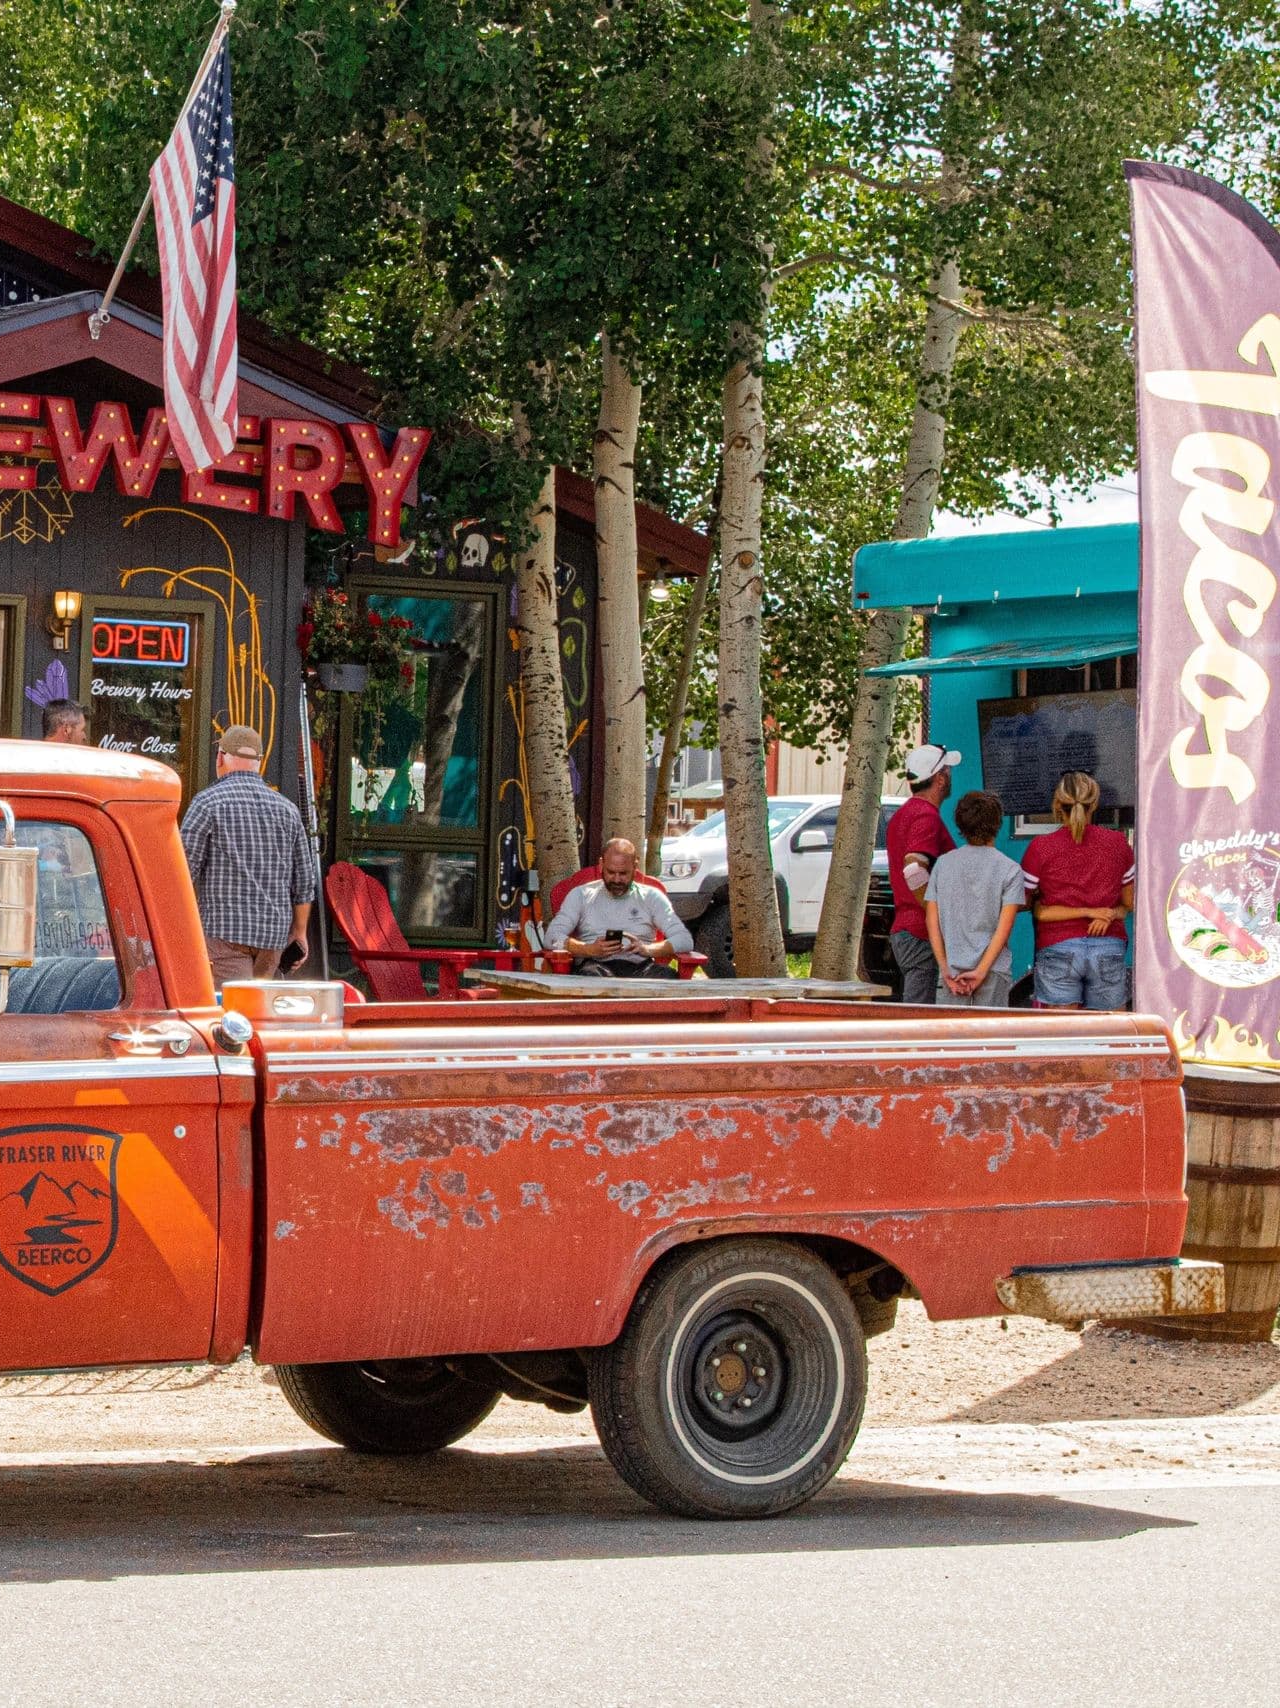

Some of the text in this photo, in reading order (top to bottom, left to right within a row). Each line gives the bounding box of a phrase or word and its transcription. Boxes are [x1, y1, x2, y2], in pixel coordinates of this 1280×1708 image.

[92, 623, 184, 661] OPEN
[91, 678, 192, 704] Brewery Hours
[141, 736, 176, 753] Close
[1179, 828, 1280, 864] Shreddy's
[1204, 852, 1247, 870] Tacos
[62, 1144, 106, 1163] RIVER
[17, 1247, 92, 1266] BEERCO
